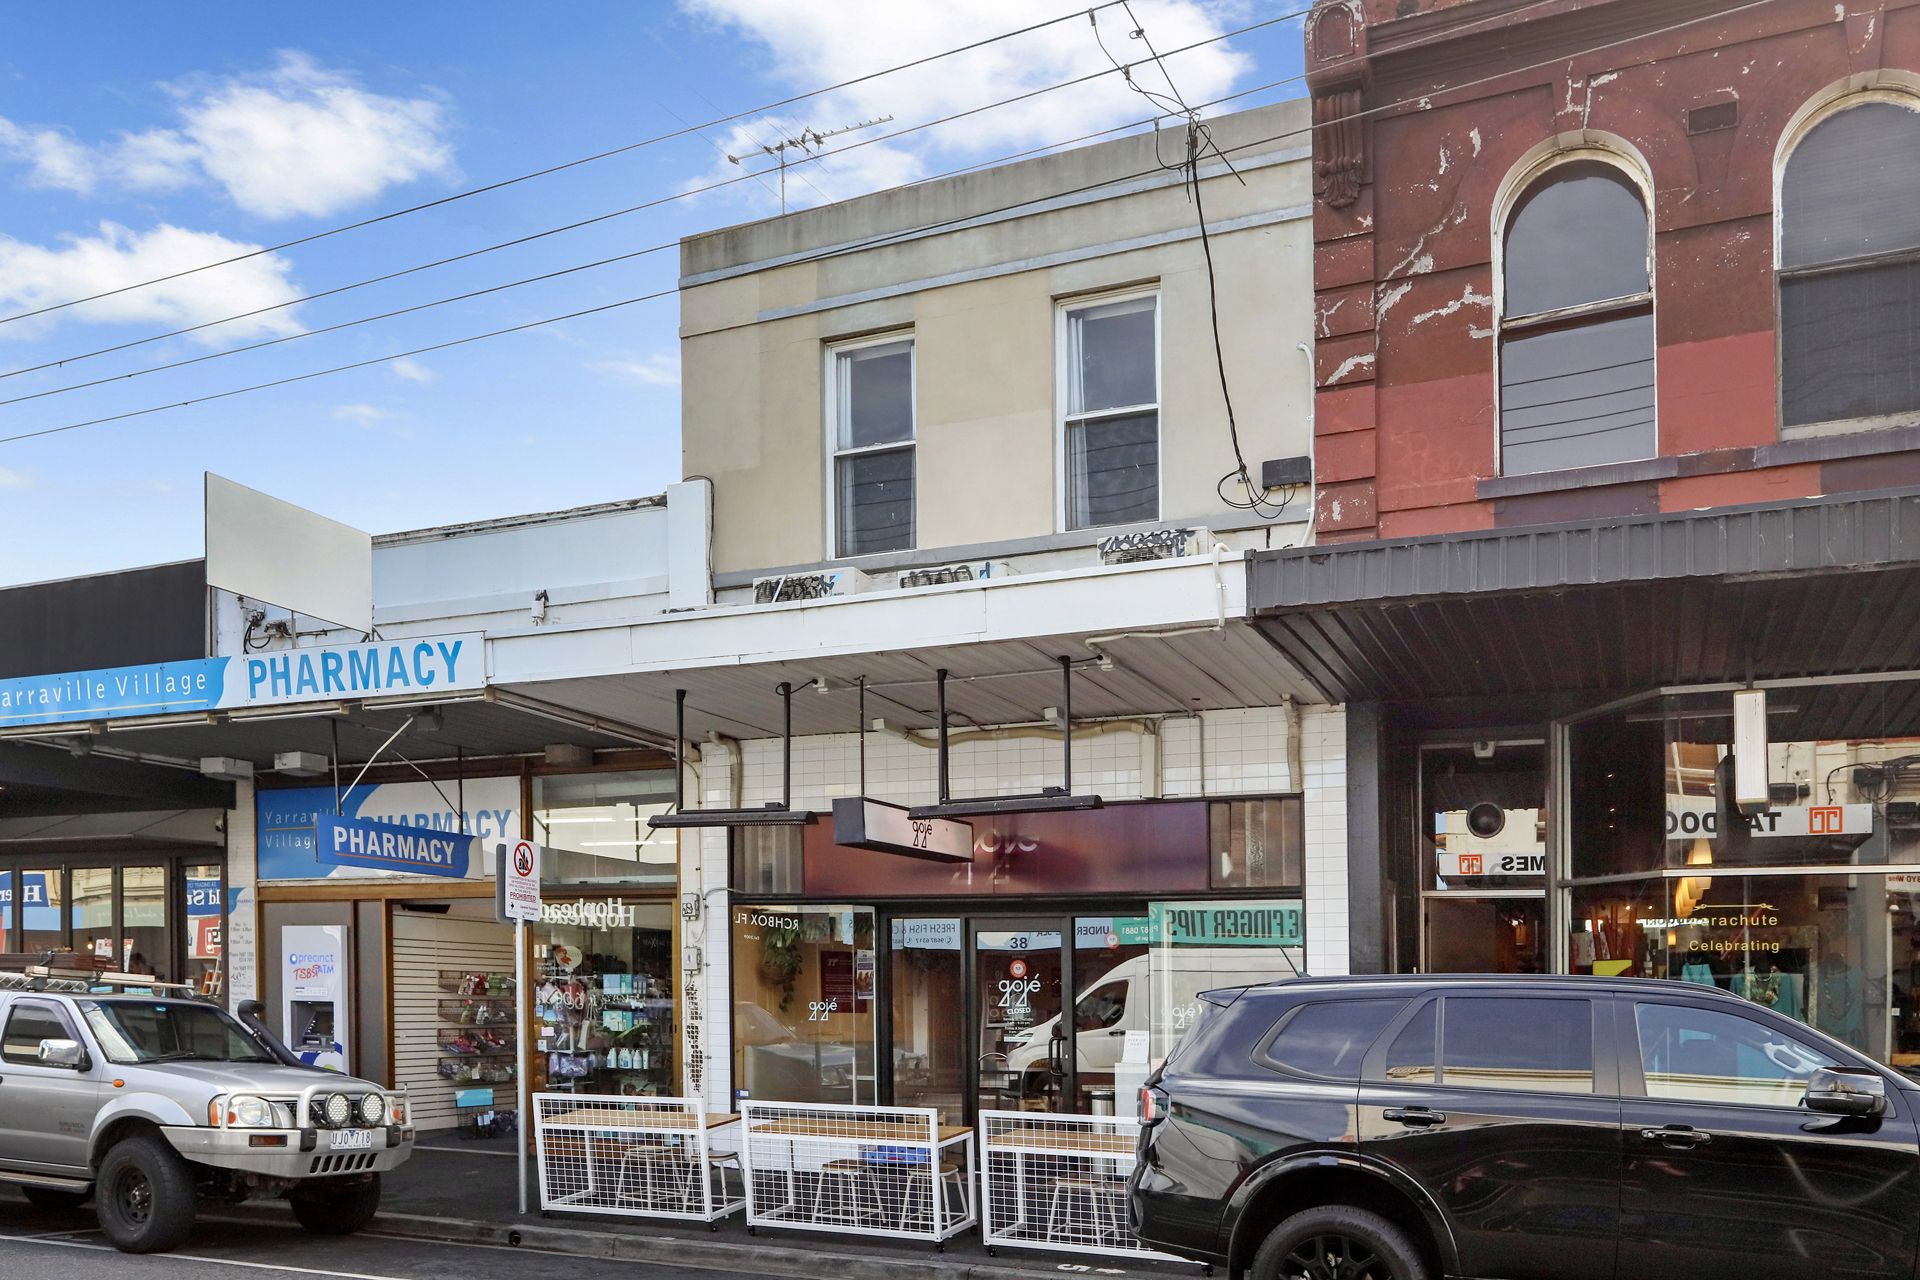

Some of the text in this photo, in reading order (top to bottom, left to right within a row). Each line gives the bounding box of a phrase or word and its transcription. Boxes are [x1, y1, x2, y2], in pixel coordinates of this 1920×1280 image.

[249, 640, 463, 699] PHARMACY
[115, 670, 207, 697] Village
[333, 826, 455, 864] PHARMACY
[510, 892, 536, 903] PROHIBITED
[1010, 937, 1028, 949] 38
[1688, 940, 1780, 953] Celebrating
[298, 953, 334, 965] precinct
[318, 965, 335, 974] ATM
[998, 973, 1041, 1007] gojé
[808, 997, 838, 1021] gojé
[1007, 1007, 1031, 1015] CLOSED
[355, 1131, 371, 1145] 718
